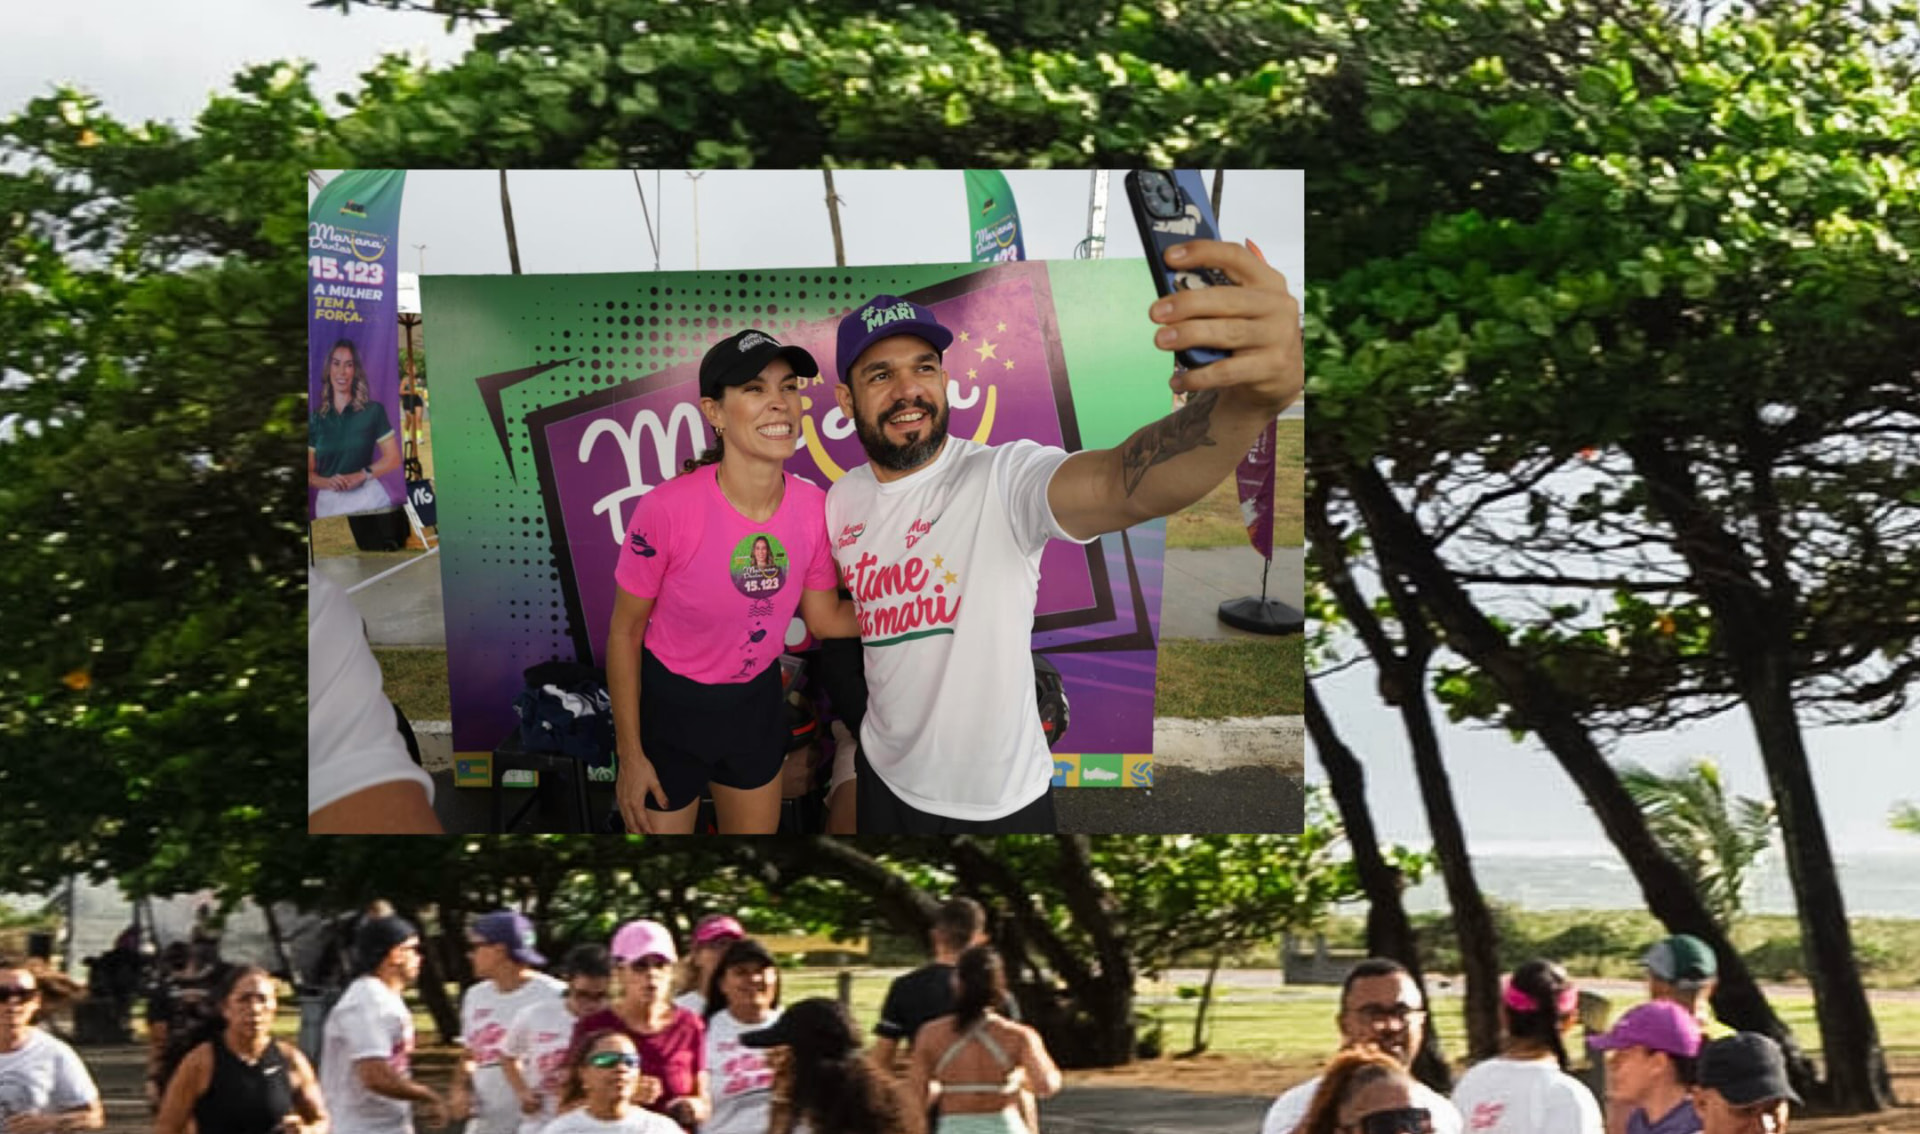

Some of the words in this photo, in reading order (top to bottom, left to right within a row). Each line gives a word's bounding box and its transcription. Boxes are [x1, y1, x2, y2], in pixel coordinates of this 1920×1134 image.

[308, 222, 384, 257] Mariana
[308, 255, 384, 285] 15.123
[313, 283, 325, 295] A
[329, 284, 383, 301] MULHER
[314, 296, 344, 309] TEM
[346, 299, 355, 310] A
[315, 309, 362, 323] FORÇA.
[867, 307, 917, 333] MARI
[744, 577, 780, 592] 15.123
[842, 552, 930, 603] #time
[873, 584, 961, 637] mari
